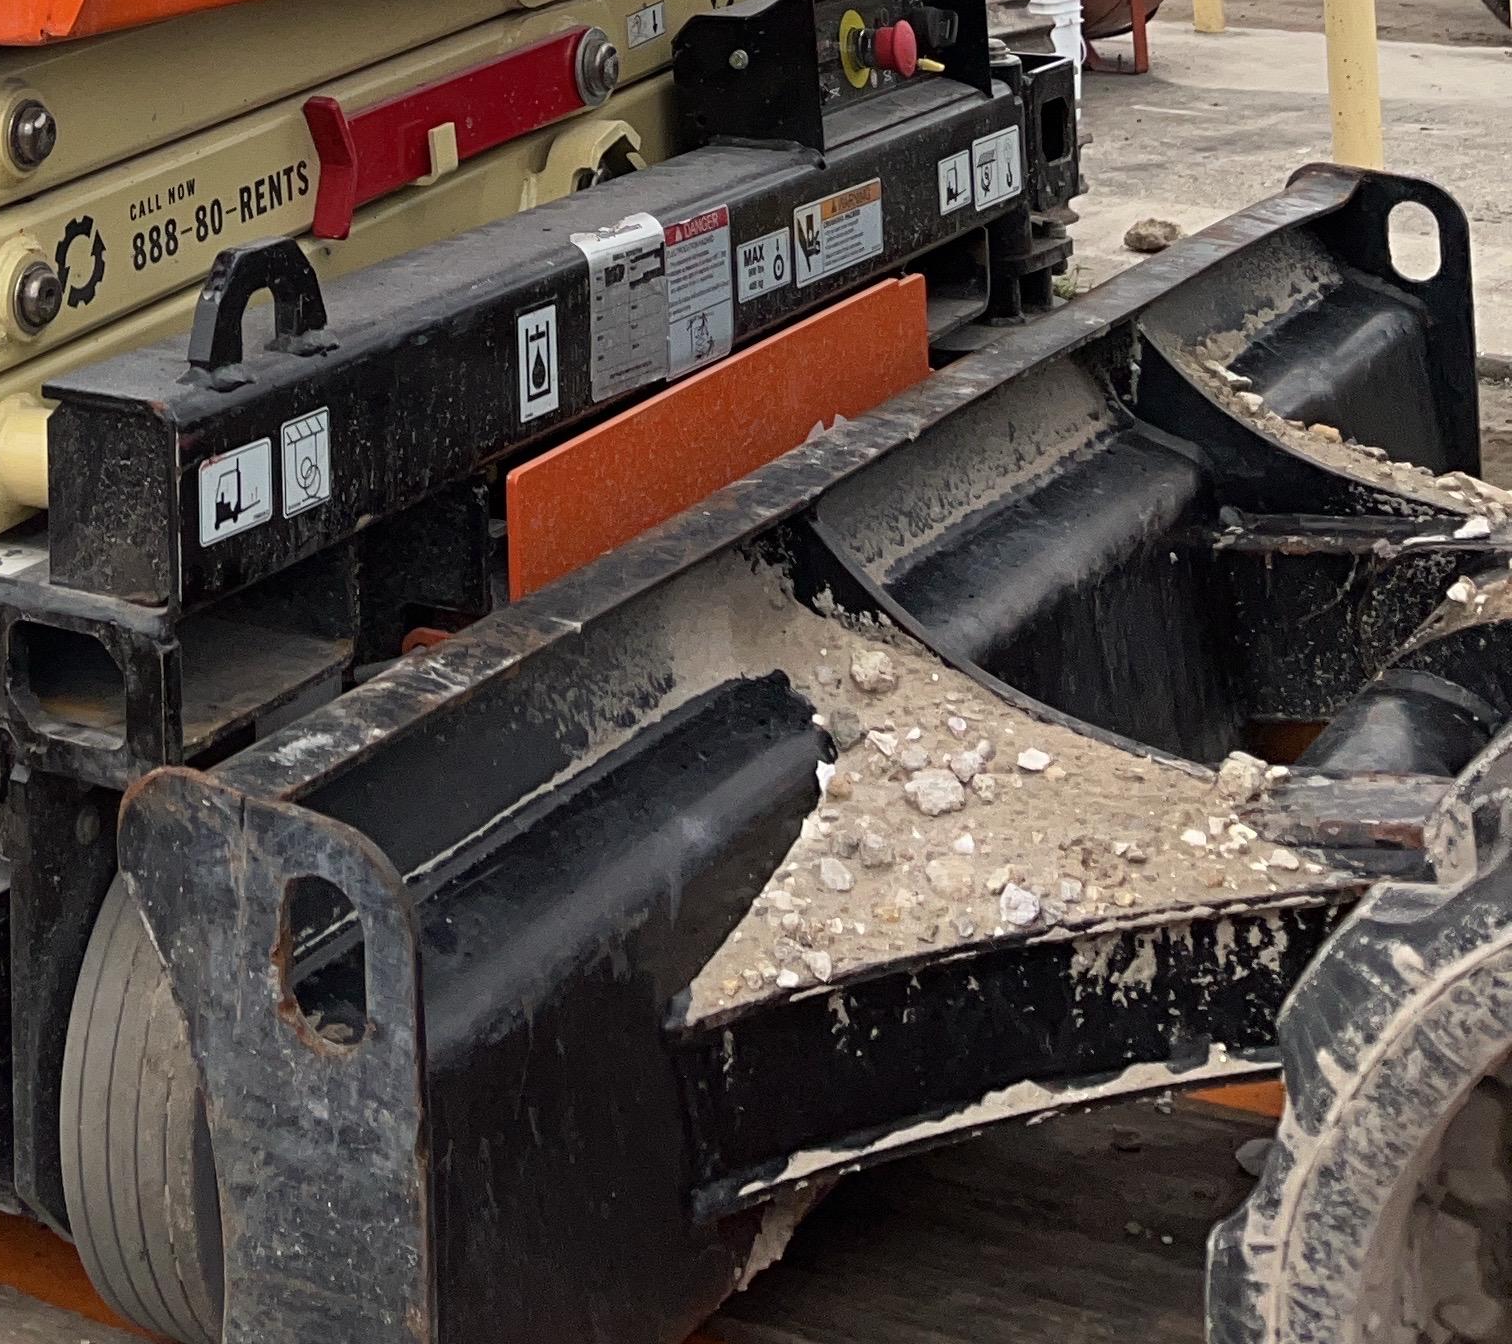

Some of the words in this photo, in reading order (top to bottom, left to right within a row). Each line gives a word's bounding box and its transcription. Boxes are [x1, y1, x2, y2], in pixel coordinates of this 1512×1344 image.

[130, 193, 163, 221] CALL
[168, 178, 196, 206] NOW
[132, 160, 309, 271] 888-80-RENTS
[683, 213, 720, 237] DANGER
[743, 244, 765, 267] MAX
